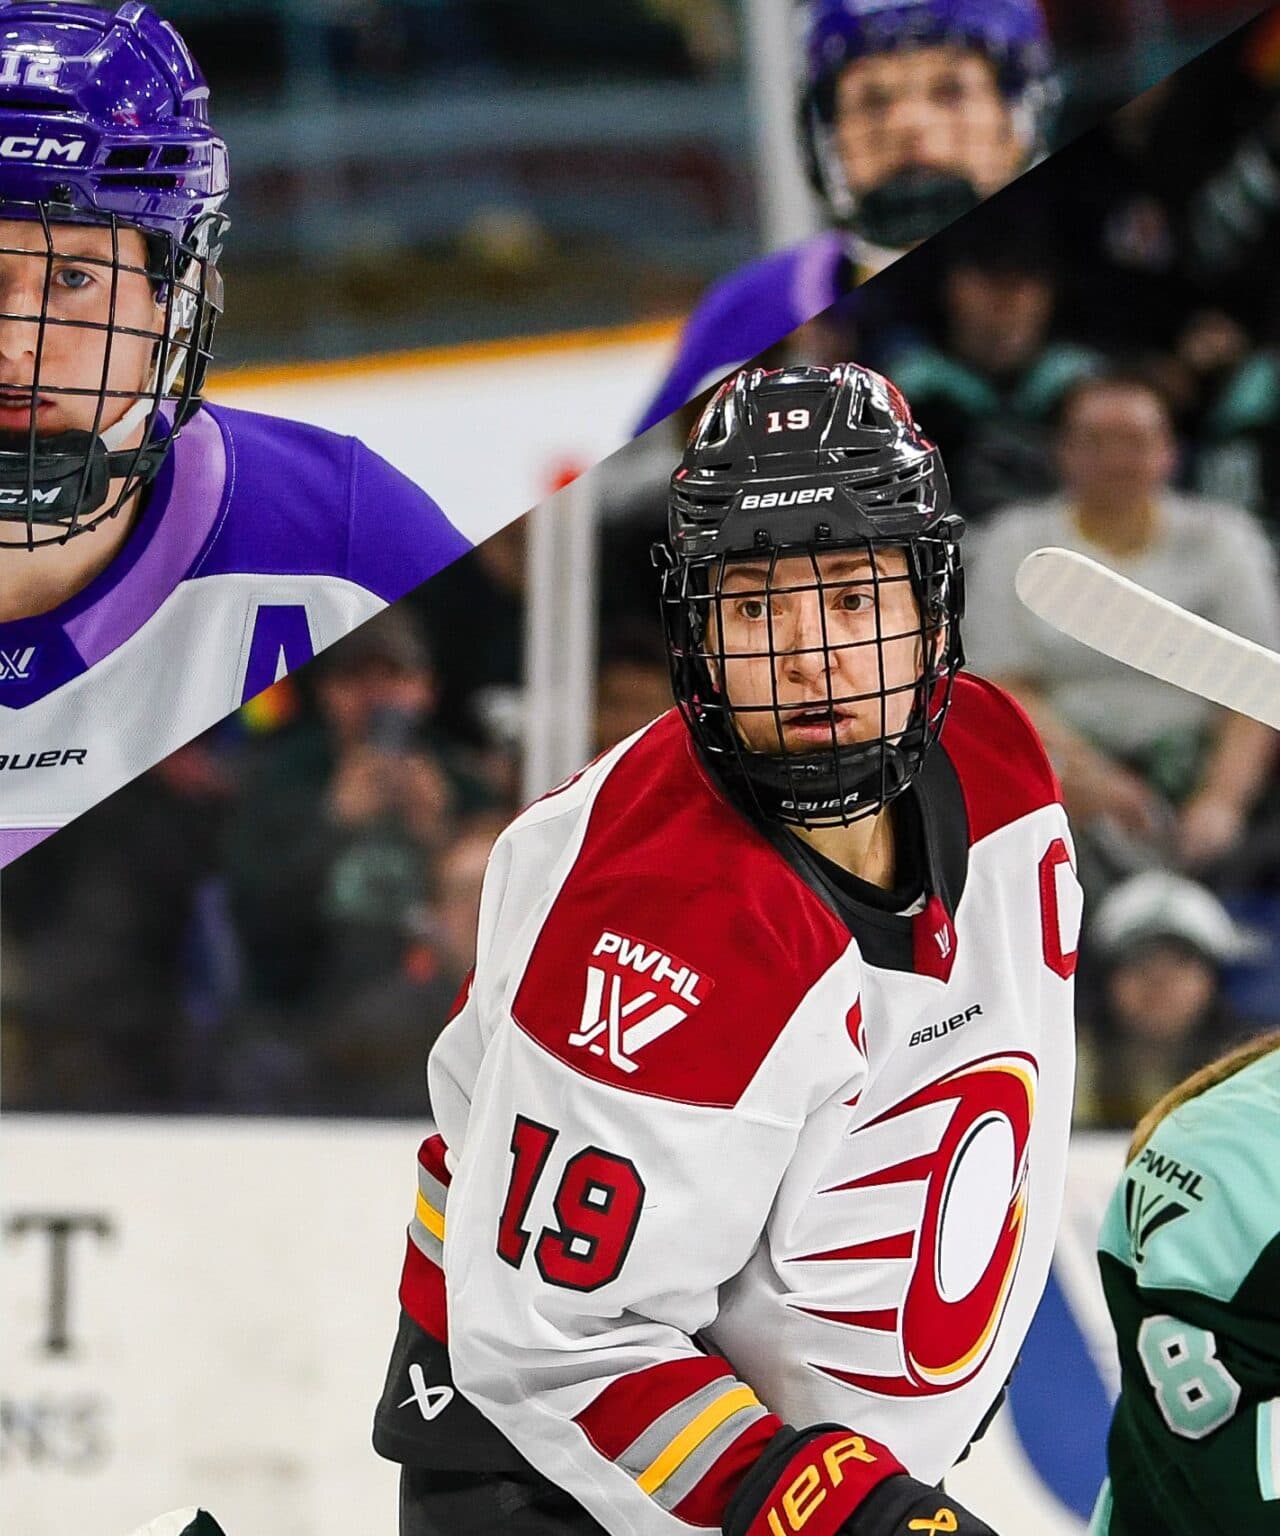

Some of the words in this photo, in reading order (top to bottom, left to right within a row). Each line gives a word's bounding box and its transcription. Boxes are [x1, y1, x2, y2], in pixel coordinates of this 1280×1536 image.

[766, 408, 811, 434] 19
[240, 604, 315, 707] A
[591, 931, 701, 1006] PWHL
[496, 1112, 646, 1294] 19
[1140, 1149, 1204, 1202] PWHL
[1137, 1314, 1242, 1440] 8
